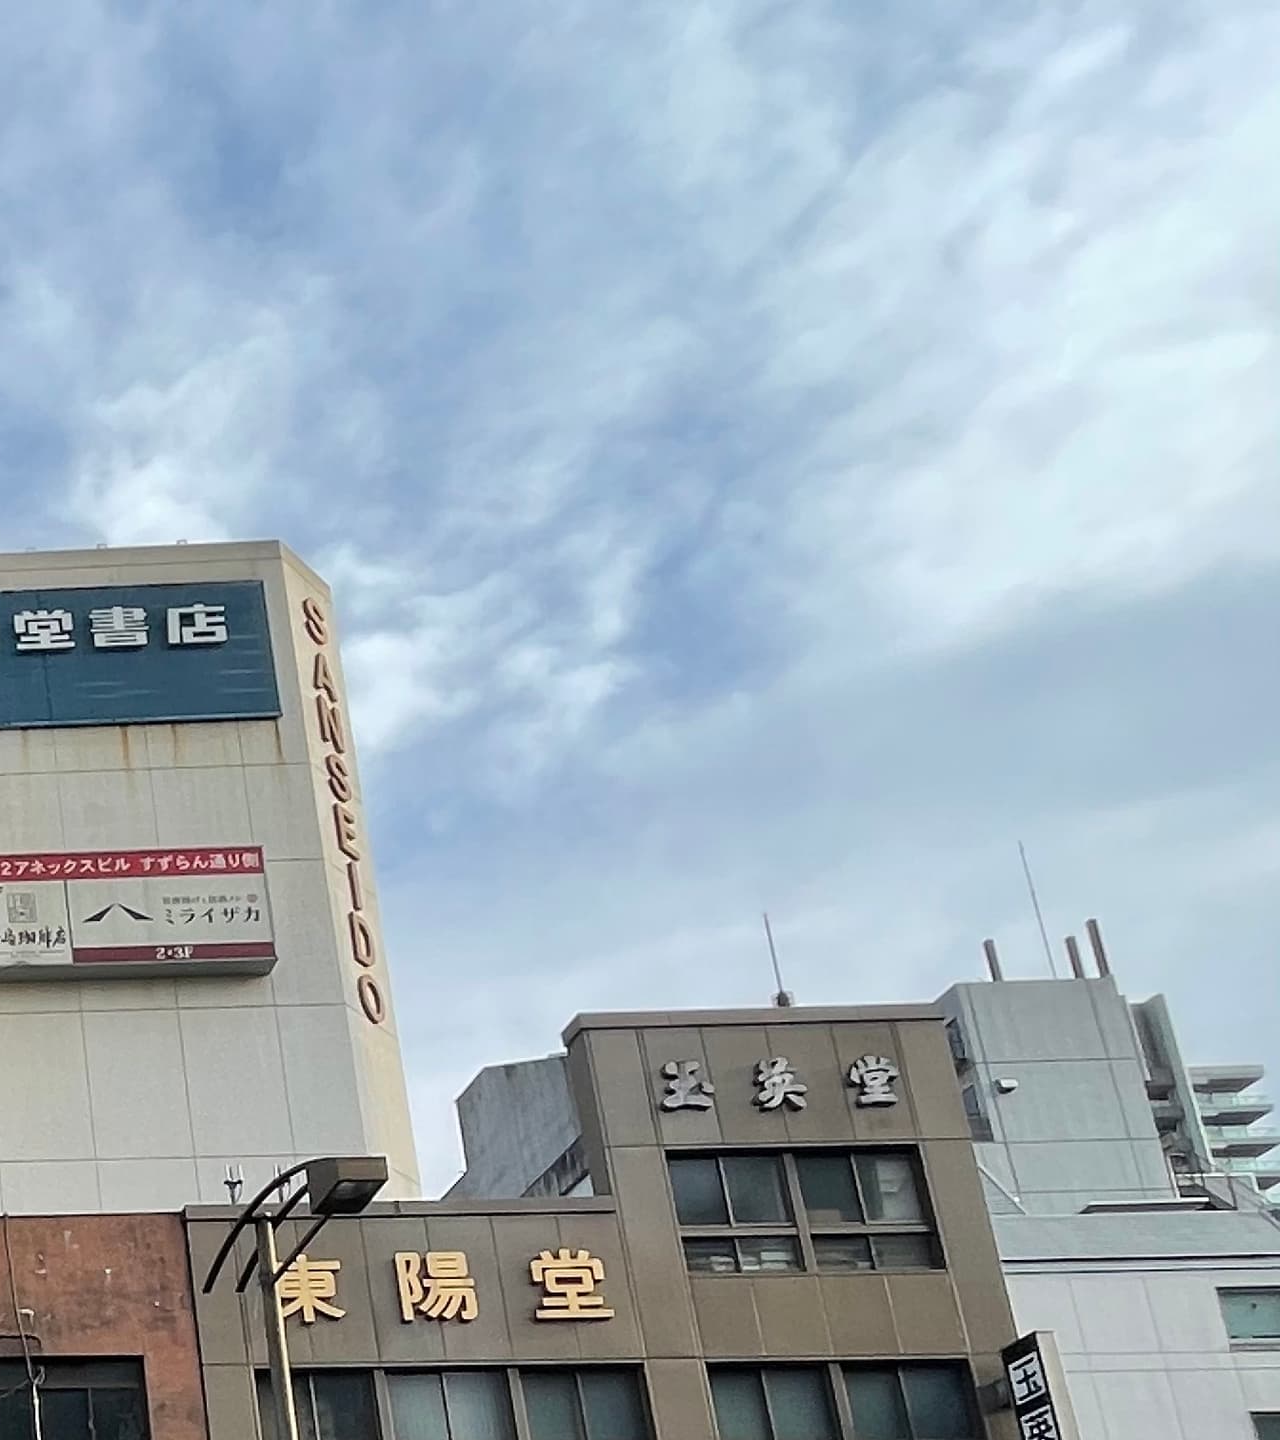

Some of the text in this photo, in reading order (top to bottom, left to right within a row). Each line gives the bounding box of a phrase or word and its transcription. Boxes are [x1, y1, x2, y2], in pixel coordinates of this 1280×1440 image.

[302, 597, 386, 1026] SANSEIDO
[140, 851, 260, 873] すずらん通り側
[164, 906, 261, 925] ミライザカ
[659, 1054, 900, 1112] 玉英堂
[276, 1248, 616, 1324] 東陽堂
